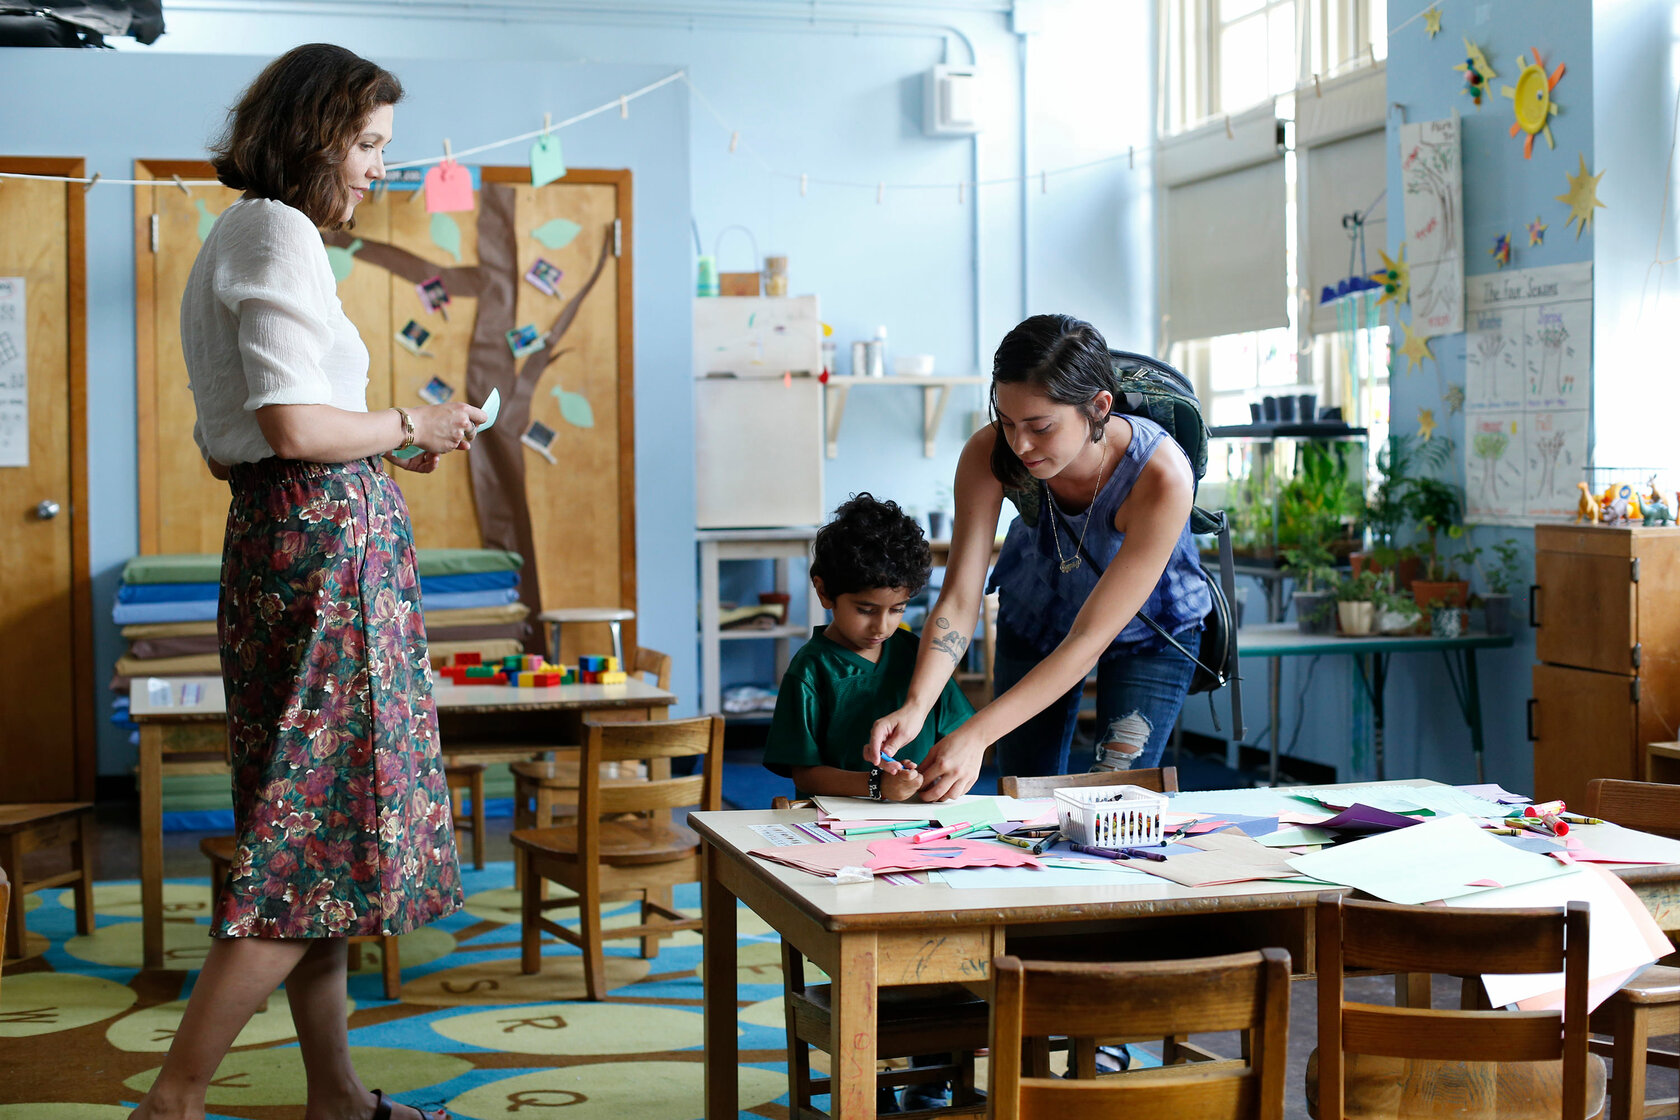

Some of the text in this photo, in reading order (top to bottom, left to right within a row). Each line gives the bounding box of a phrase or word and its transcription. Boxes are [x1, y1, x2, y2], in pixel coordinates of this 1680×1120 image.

[440, 979, 499, 994] S
[496, 1015, 568, 1033] R
[505, 1089, 588, 1112] Q
